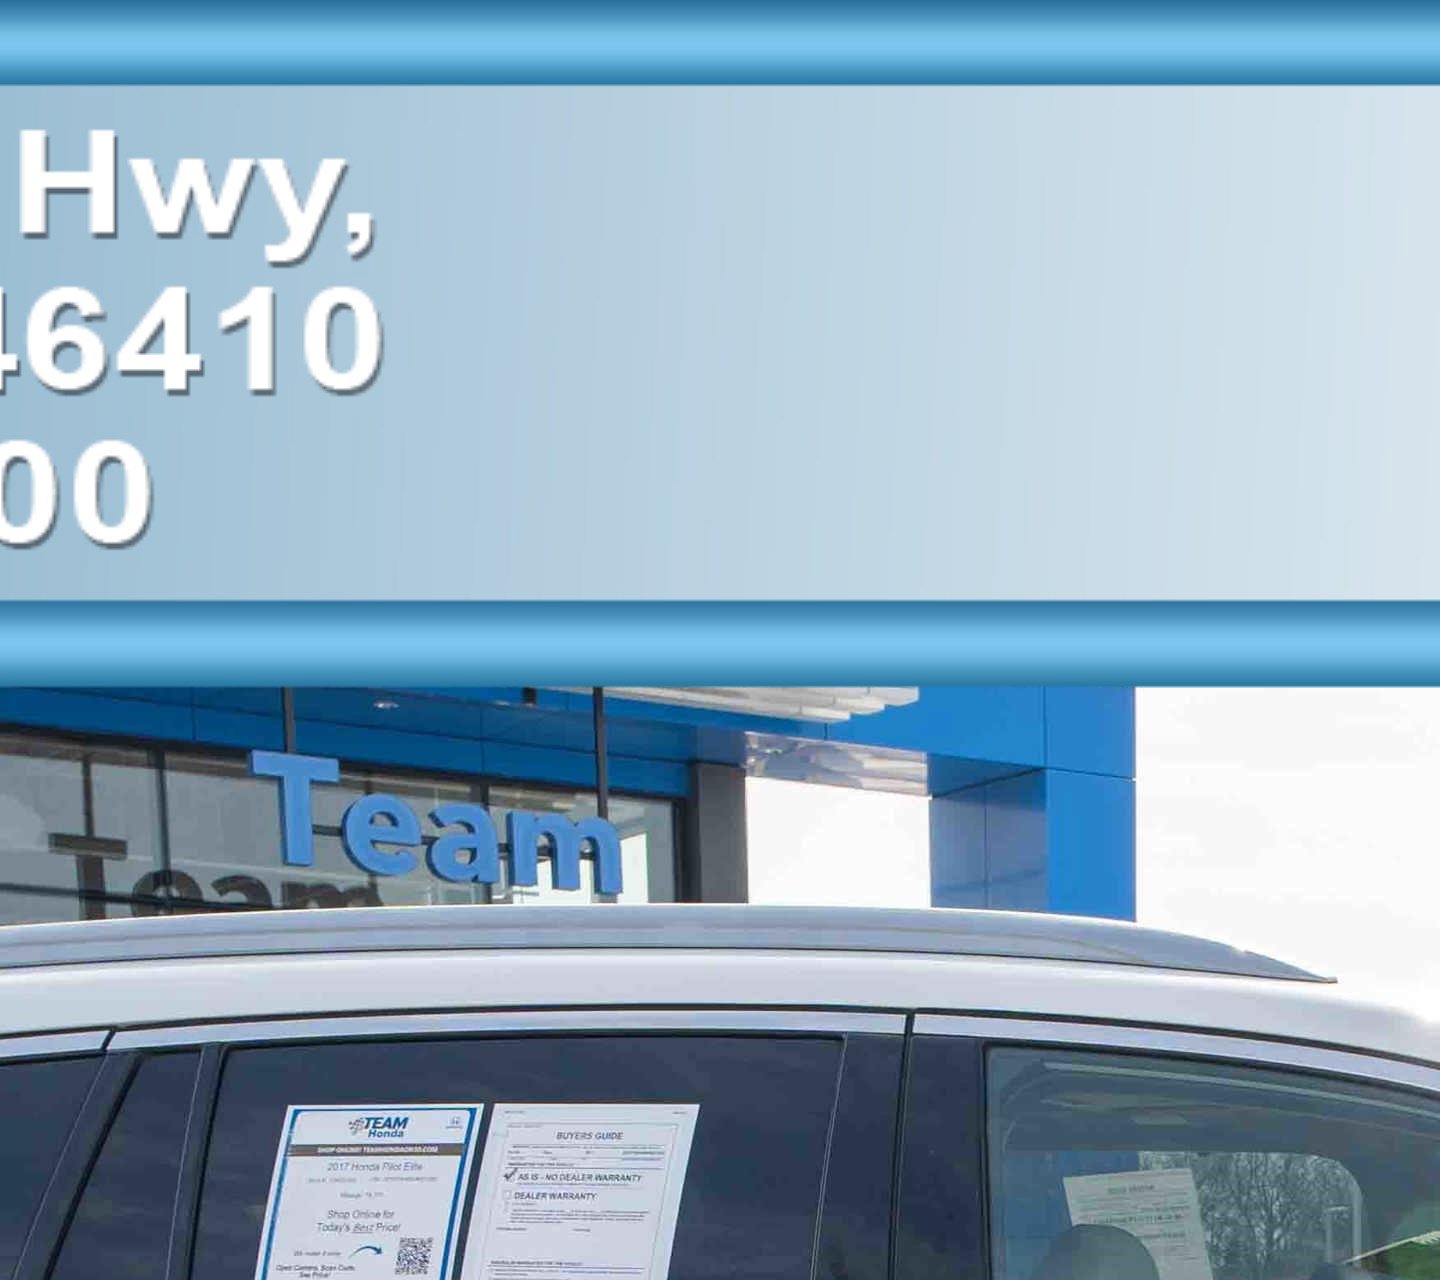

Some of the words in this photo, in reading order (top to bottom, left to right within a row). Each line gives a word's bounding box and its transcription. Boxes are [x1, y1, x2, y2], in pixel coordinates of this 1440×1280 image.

[249, 749, 622, 895] Team
[363, 1117, 408, 1129] TEAM
[368, 1129, 404, 1138] Honda
[556, 1132, 593, 1140] BUYERS
[594, 1132, 625, 1140] GUIDE
[327, 1162, 349, 1171] 2017
[351, 1162, 380, 1171] Honda
[382, 1162, 402, 1171] Pilot
[517, 1173, 529, 1181] AS
[530, 1173, 539, 1181] IS
[545, 1173, 558, 1181] NO
[594, 1174, 642, 1182] WARRANTY
[514, 1192, 548, 1200] DEALER
[328, 1210, 351, 1220] Shop
[352, 1210, 381, 1219] Online
[383, 1210, 395, 1218] for
[317, 1222, 350, 1233] Today's
[352, 1223, 374, 1232] Best
[375, 1223, 401, 1232] Price!
